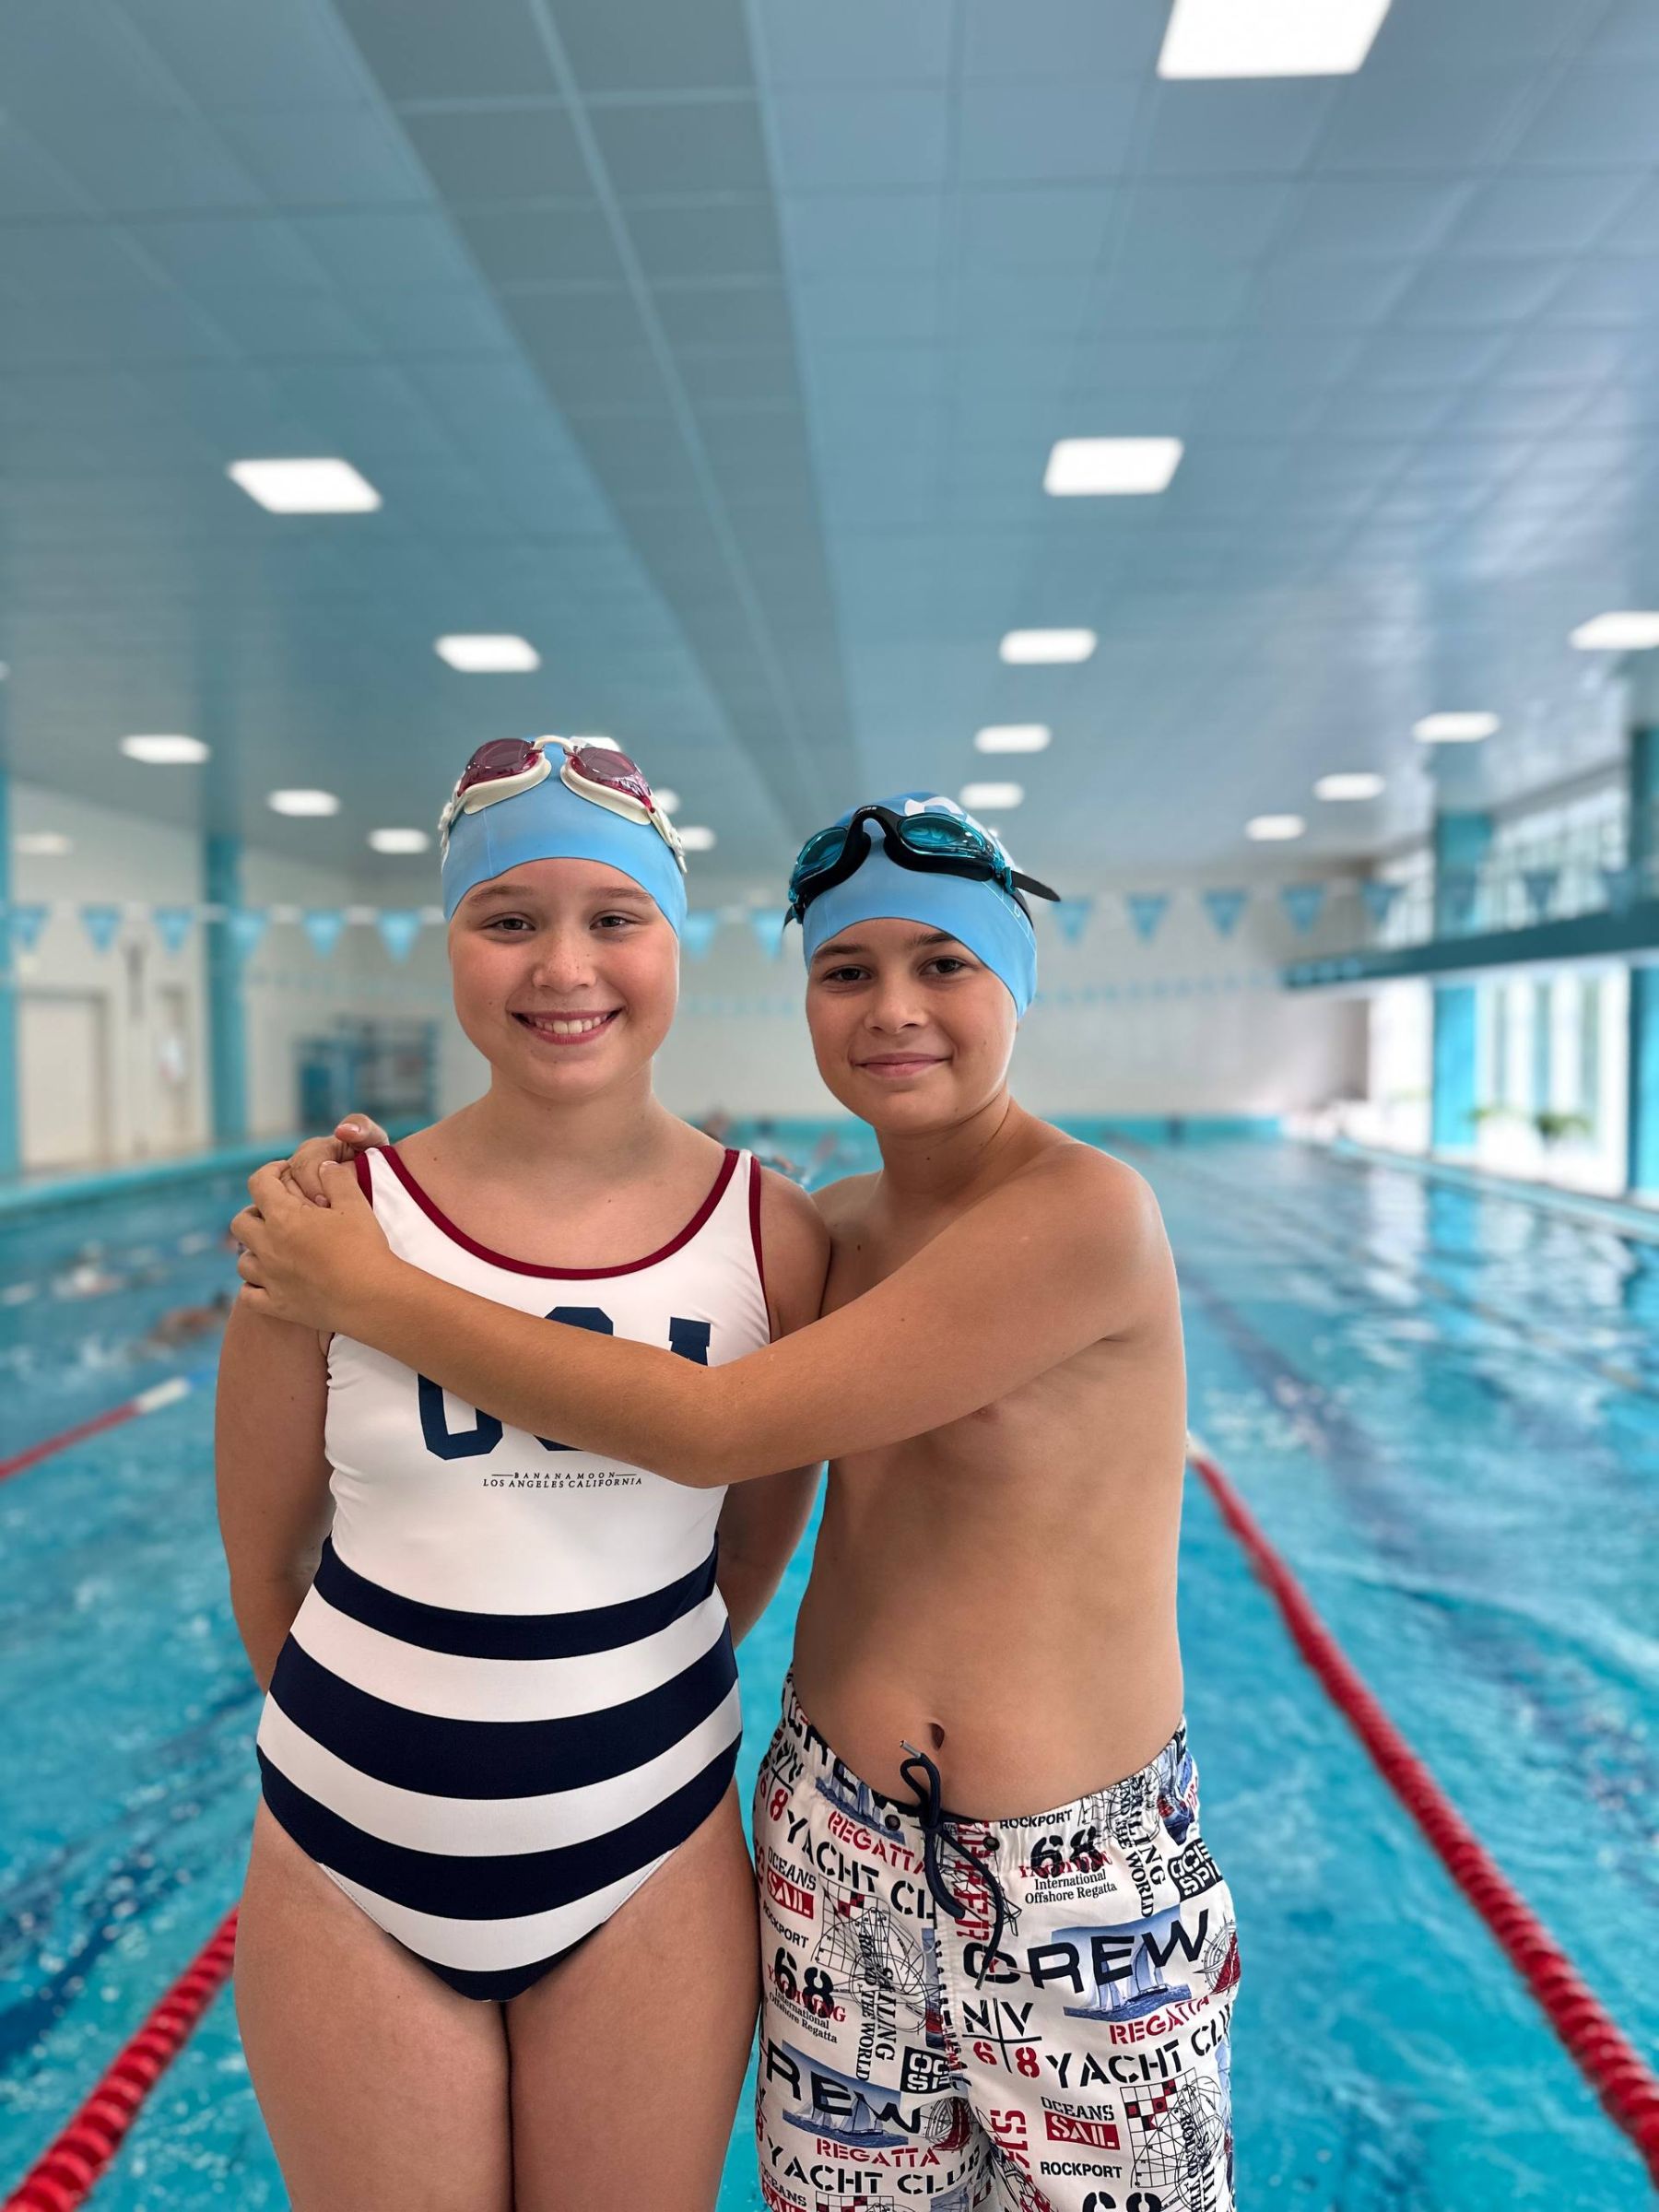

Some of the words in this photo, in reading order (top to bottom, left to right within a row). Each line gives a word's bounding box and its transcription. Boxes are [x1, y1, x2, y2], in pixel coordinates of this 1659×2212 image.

[509, 1479, 564, 1488] ANGELES
[568, 1477, 642, 1488] CALIFORNIA
[999, 1809, 1073, 1830] ROCKPORT
[768, 1846, 817, 1890] OCEANS
[788, 1808, 879, 1892] YACHT
[1030, 1825, 1102, 1879] 68
[768, 1869, 811, 1916] SAIL
[1025, 1890, 1074, 1904] Offshore
[1077, 1881, 1118, 1899] Regatta
[1035, 1868, 1107, 1890] International
[1125, 1851, 1154, 1918] WORLD
[964, 1908, 1208, 1994] CREW
[774, 1947, 834, 2018] 68
[774, 1987, 830, 2030] International
[861, 1990, 876, 2021] THE
[1110, 1996, 1209, 2045] REGATTA
[801, 2018, 838, 2044] Regatta
[855, 2021, 876, 2080] WORLD
[763, 2037, 920, 2134] REW
[1045, 2039, 1182, 2088] YACHT
[1041, 2096, 1114, 2121] OCEANS
[1051, 2114, 1116, 2147] SAIL
[768, 2135, 883, 2194] YACHT
[816, 2137, 940, 2167] REGATTA
[1040, 2160, 1123, 2179] ROCKPORT
